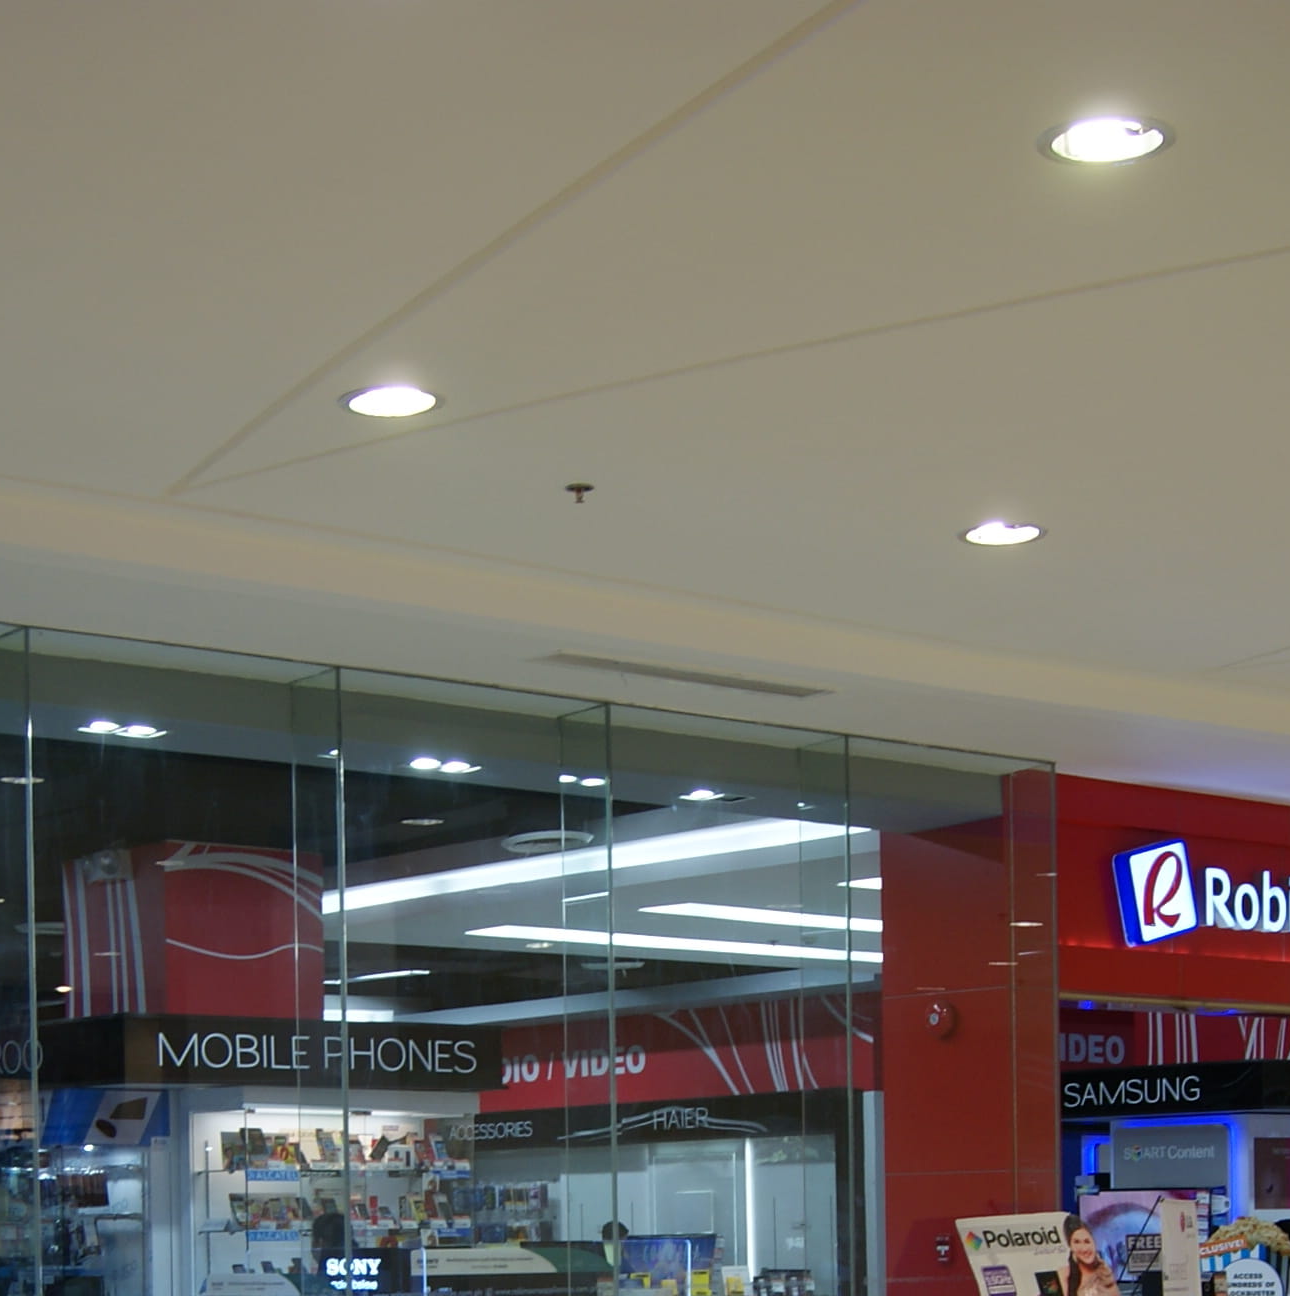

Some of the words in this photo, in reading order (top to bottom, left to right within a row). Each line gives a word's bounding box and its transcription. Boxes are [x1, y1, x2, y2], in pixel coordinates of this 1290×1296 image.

[158, 1031, 310, 1070] MOBILE
[324, 1037, 477, 1074] PHONES
[563, 1045, 646, 1080] VIDEO
[1063, 1075, 1202, 1108] SAMSUNG
[653, 1106, 709, 1131] HAIER
[449, 1121, 534, 1142] ACCESSORIES
[1167, 1145, 1215, 1161] Content
[982, 1227, 1062, 1249] Polaroid
[1127, 1236, 1162, 1250] FREE
[326, 1257, 382, 1277] SONY
